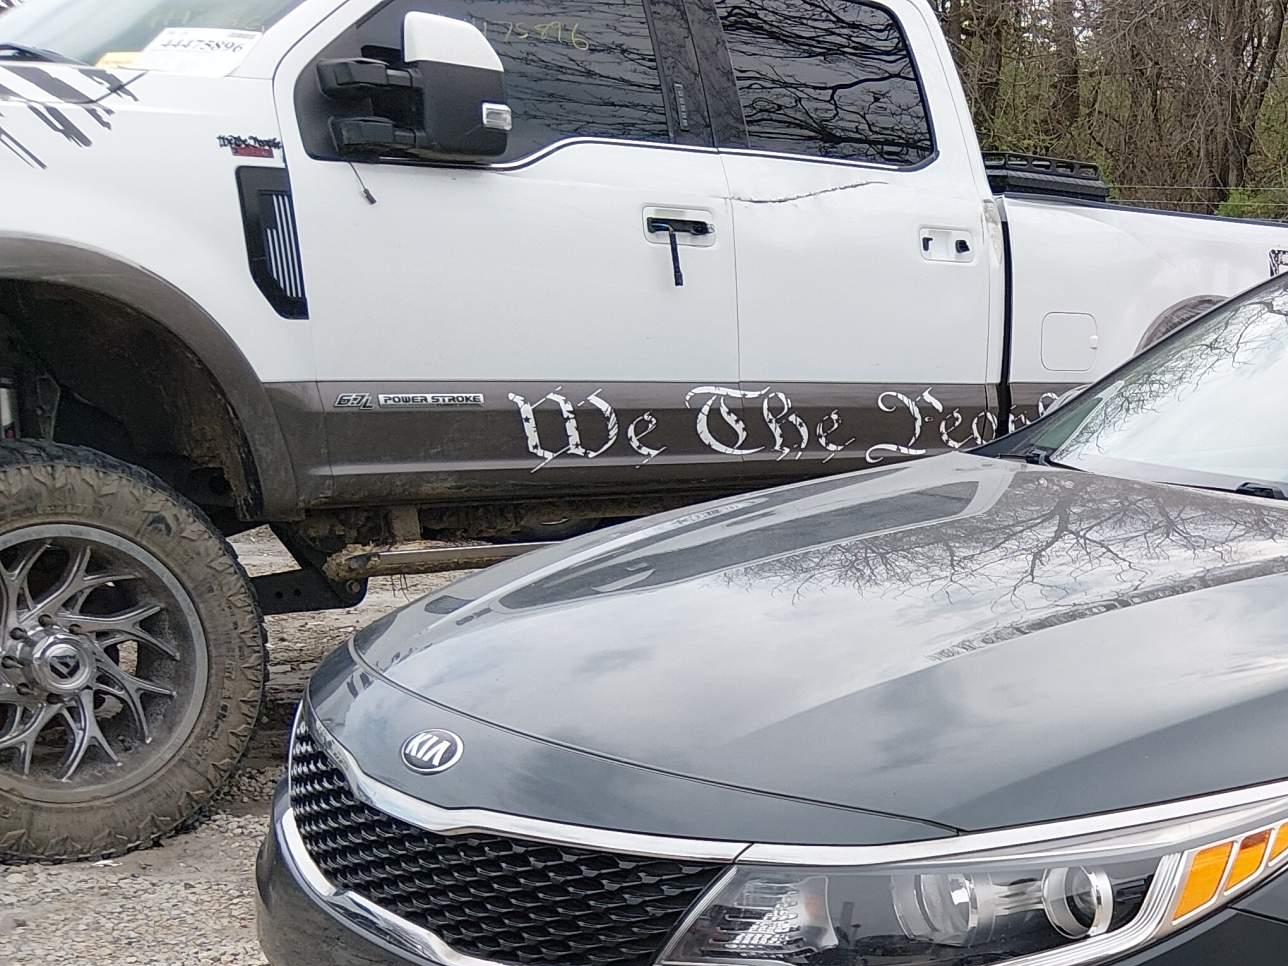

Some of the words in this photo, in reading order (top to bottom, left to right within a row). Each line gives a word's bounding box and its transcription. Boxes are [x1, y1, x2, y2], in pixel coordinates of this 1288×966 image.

[384, 395, 429, 404] POWER
[431, 395, 482, 404] STROKE
[508, 385, 667, 473] We
[685, 385, 857, 464] The
[865, 386, 1059, 464] Peo
[403, 731, 454, 768] KIA
